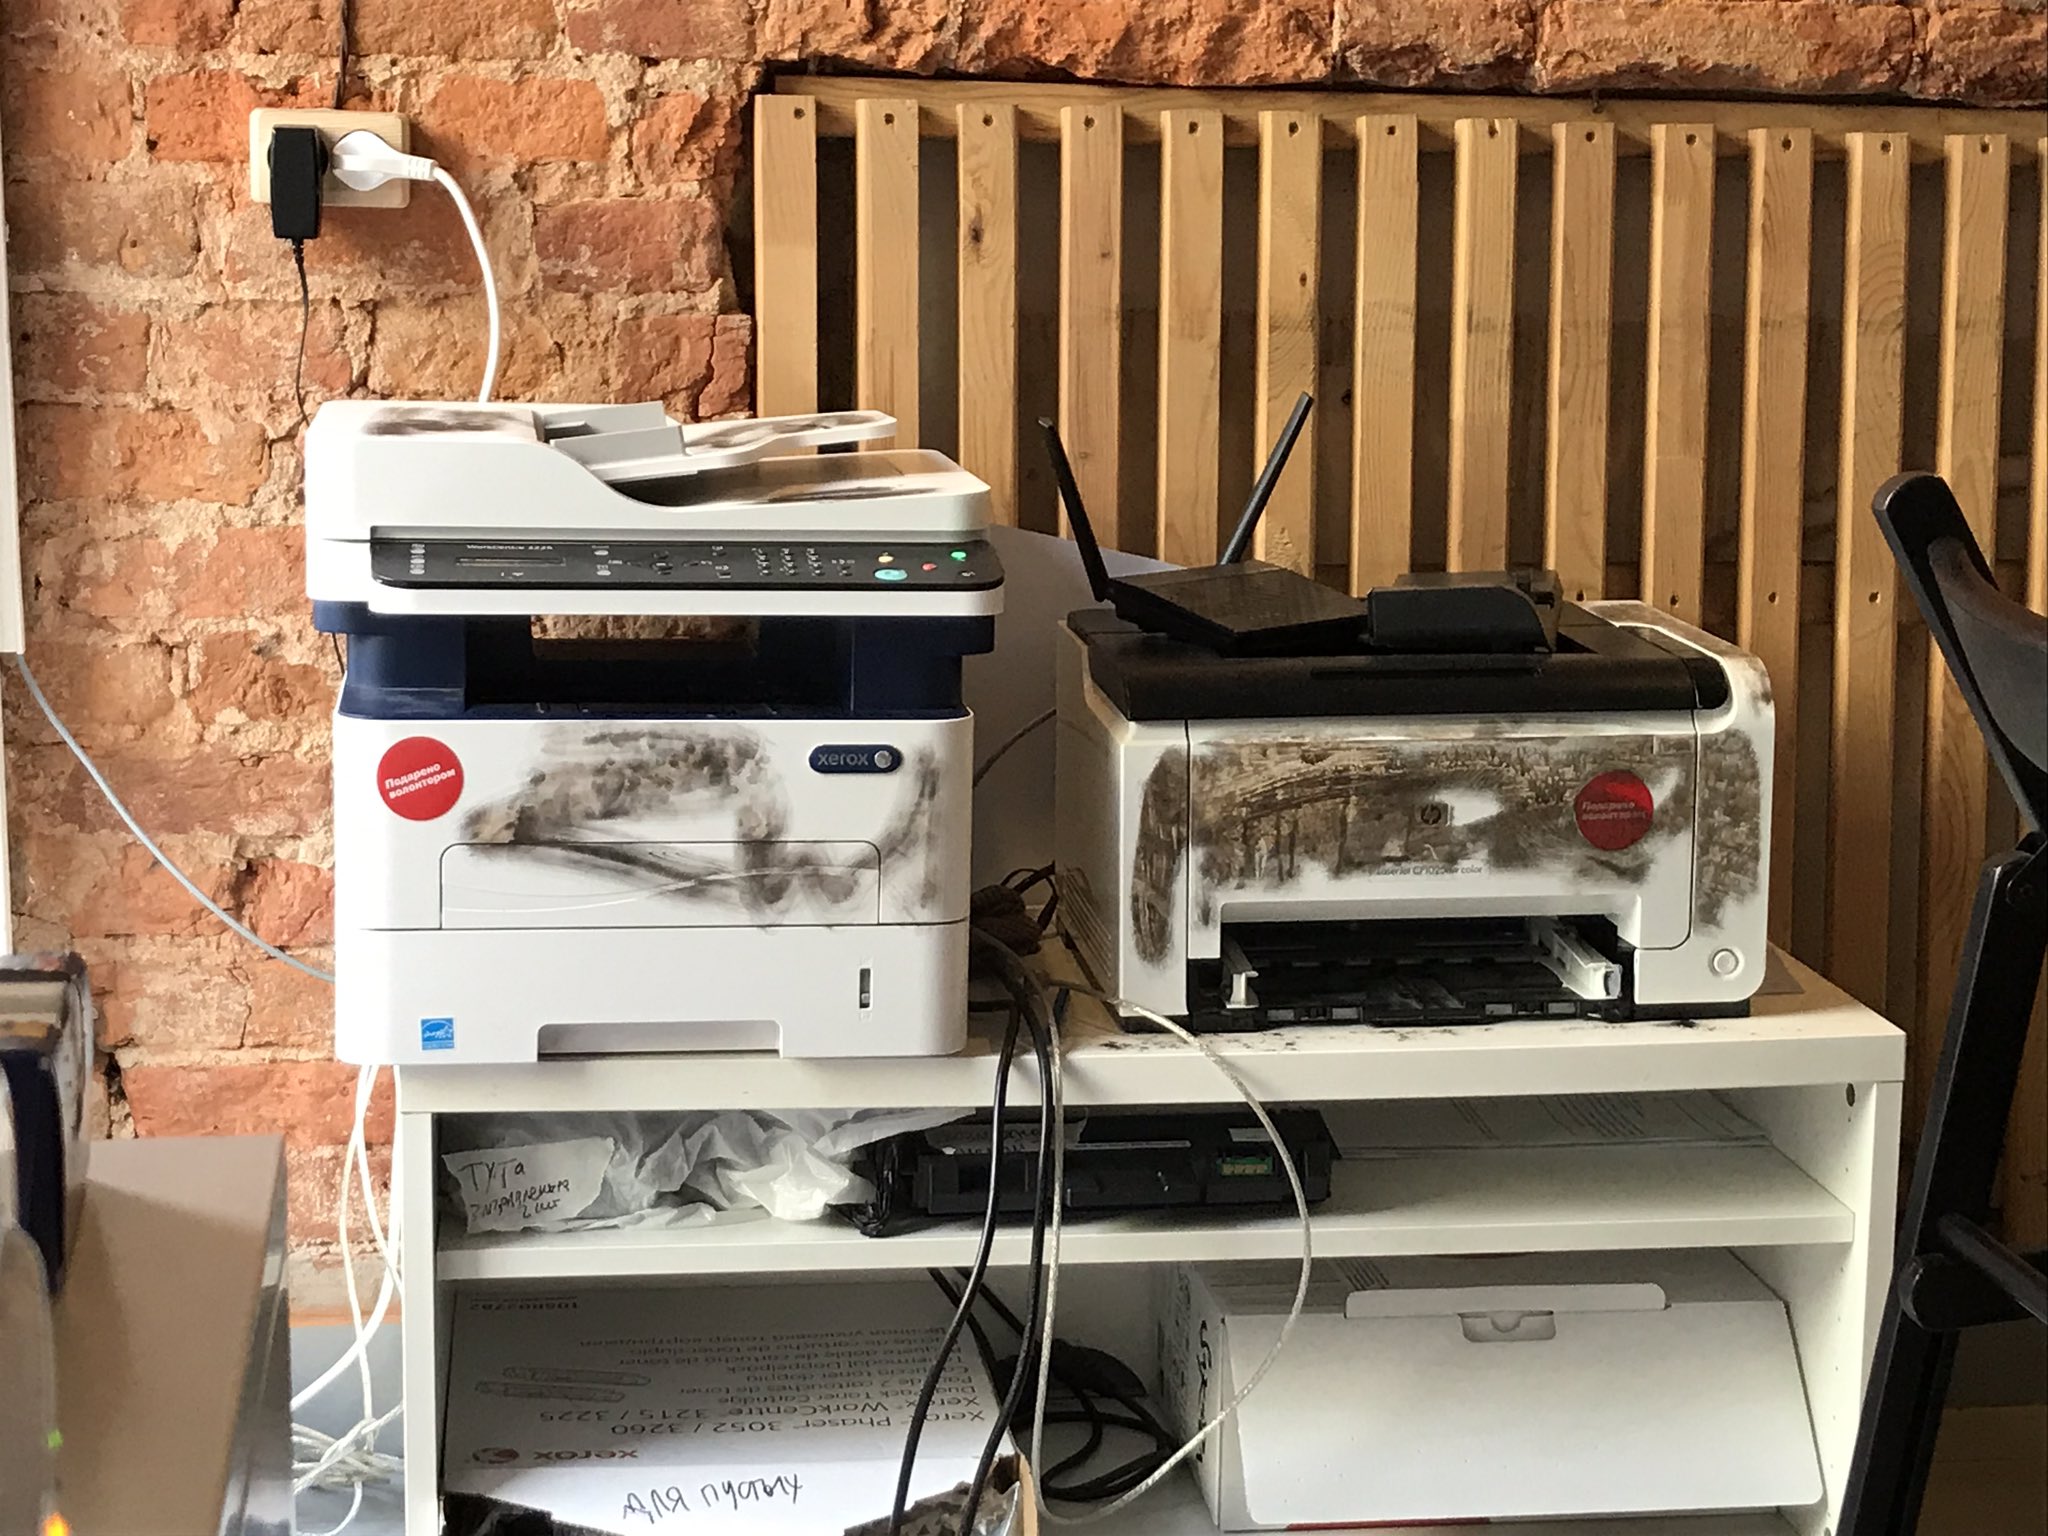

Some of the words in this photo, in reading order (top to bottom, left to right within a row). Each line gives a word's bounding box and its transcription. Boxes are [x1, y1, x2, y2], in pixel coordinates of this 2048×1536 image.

[817, 753, 869, 766] xerox
[384, 763, 441, 790] Подарено
[388, 768, 456, 799] волонтером
[1461, 864, 1482, 874] color
[932, 1385, 976, 1395] Dua
[639, 1408, 711, 1421] 3215
[727, 1401, 889, 1417] WorkCentre
[538, 1409, 610, 1423] 3225
[803, 1416, 892, 1429] Phaser
[908, 1410, 985, 1423] Xero
[610, 1422, 682, 1435] 3260
[712, 1420, 783, 1433] 3052
[533, 1449, 639, 1461] xerox
